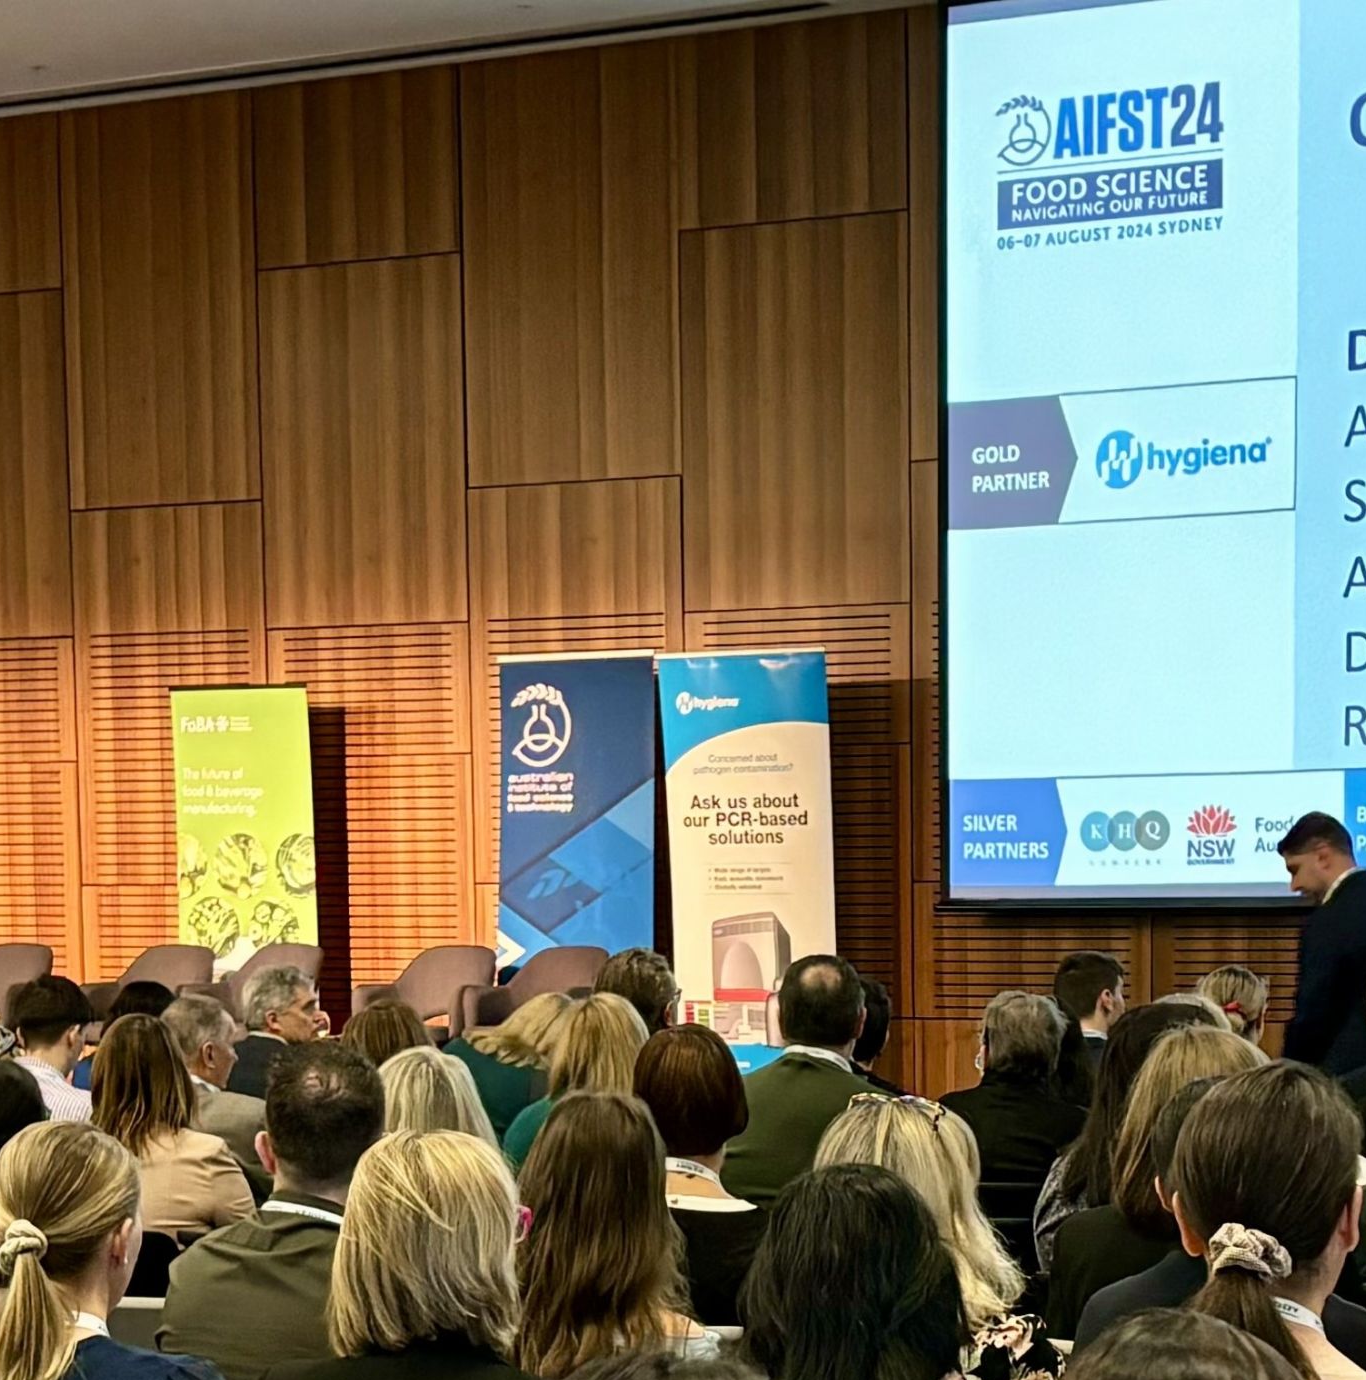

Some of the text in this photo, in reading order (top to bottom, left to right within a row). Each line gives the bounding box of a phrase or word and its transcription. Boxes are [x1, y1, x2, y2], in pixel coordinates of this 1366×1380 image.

[1053, 80, 1224, 160] AIFST24
[1011, 164, 1209, 206] FOOD SCIENCE
[1011, 190, 1208, 222] NAVIGATING OUR FUTURE
[1046, 227, 1112, 246] AUGUST
[1117, 222, 1153, 239] 2024
[1158, 216, 1223, 236] SYDNEY
[972, 445, 1020, 464] GOLD
[972, 471, 1050, 492] PARTNER
[690, 793, 799, 809] Ask us about
[683, 810, 808, 827] our PCR-based
[963, 815, 1017, 832] SILVER
[708, 829, 784, 845] solutions
[963, 842, 1049, 860] PARTNERS
[1187, 839, 1236, 858] NSW
